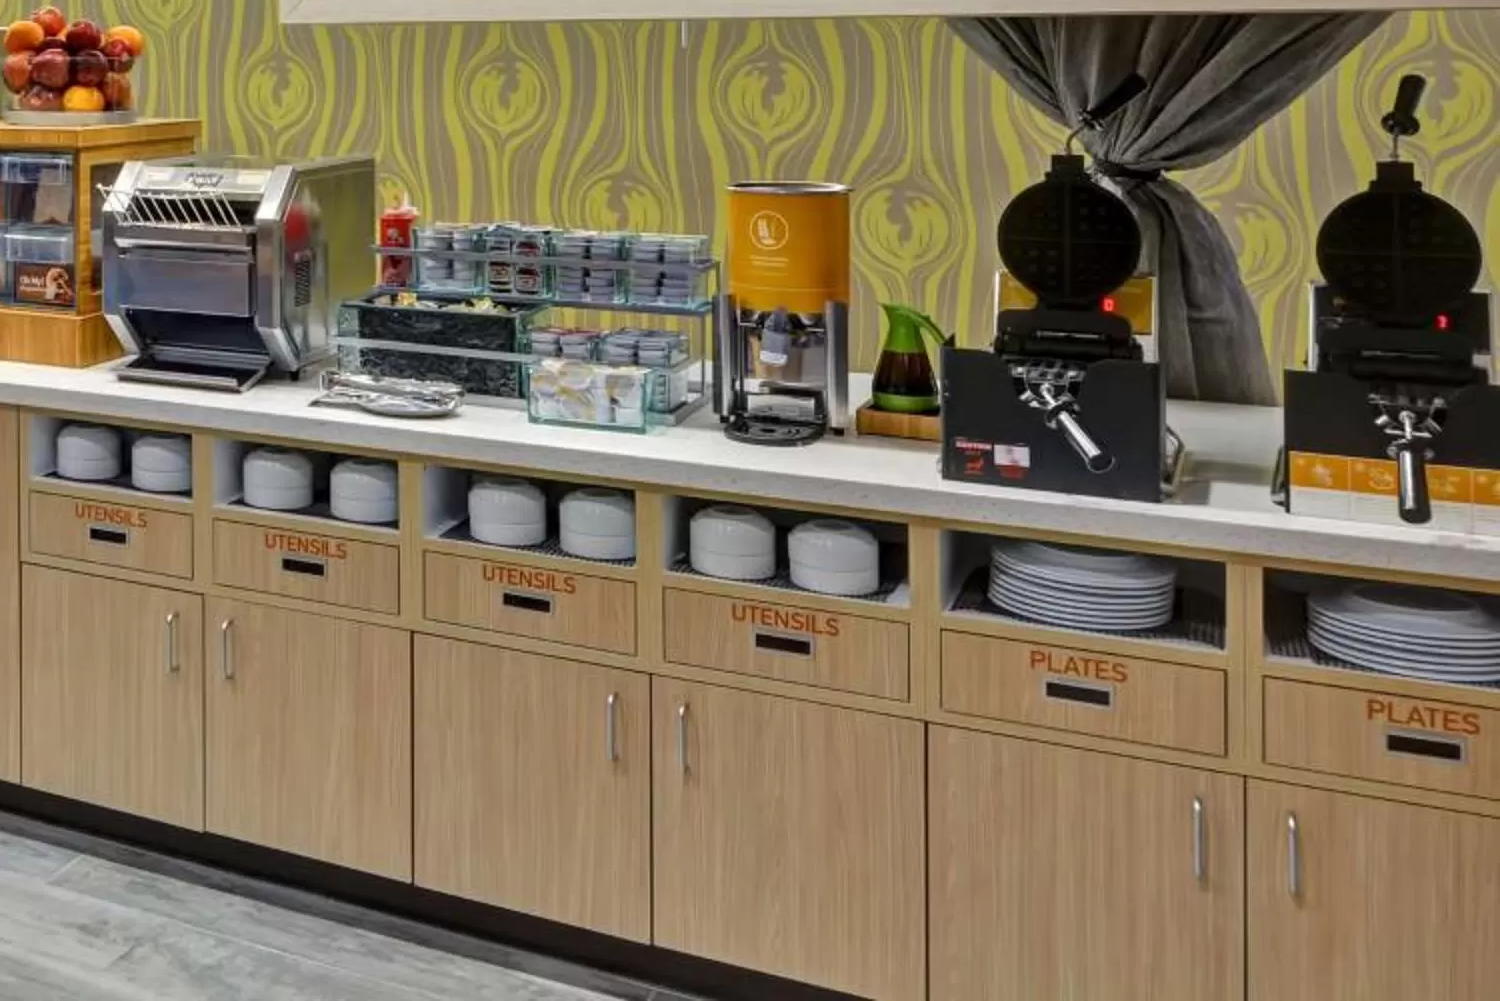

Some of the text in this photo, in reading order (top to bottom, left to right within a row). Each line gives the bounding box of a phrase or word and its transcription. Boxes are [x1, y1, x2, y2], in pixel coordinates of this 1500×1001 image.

[75, 502, 148, 528] UTENSILS
[265, 531, 348, 559] UTENSILS
[482, 564, 577, 595] UTENSILS
[731, 603, 841, 637] UTENSILS
[1029, 650, 1128, 683] PLATES
[1366, 698, 1481, 735] PLATES
